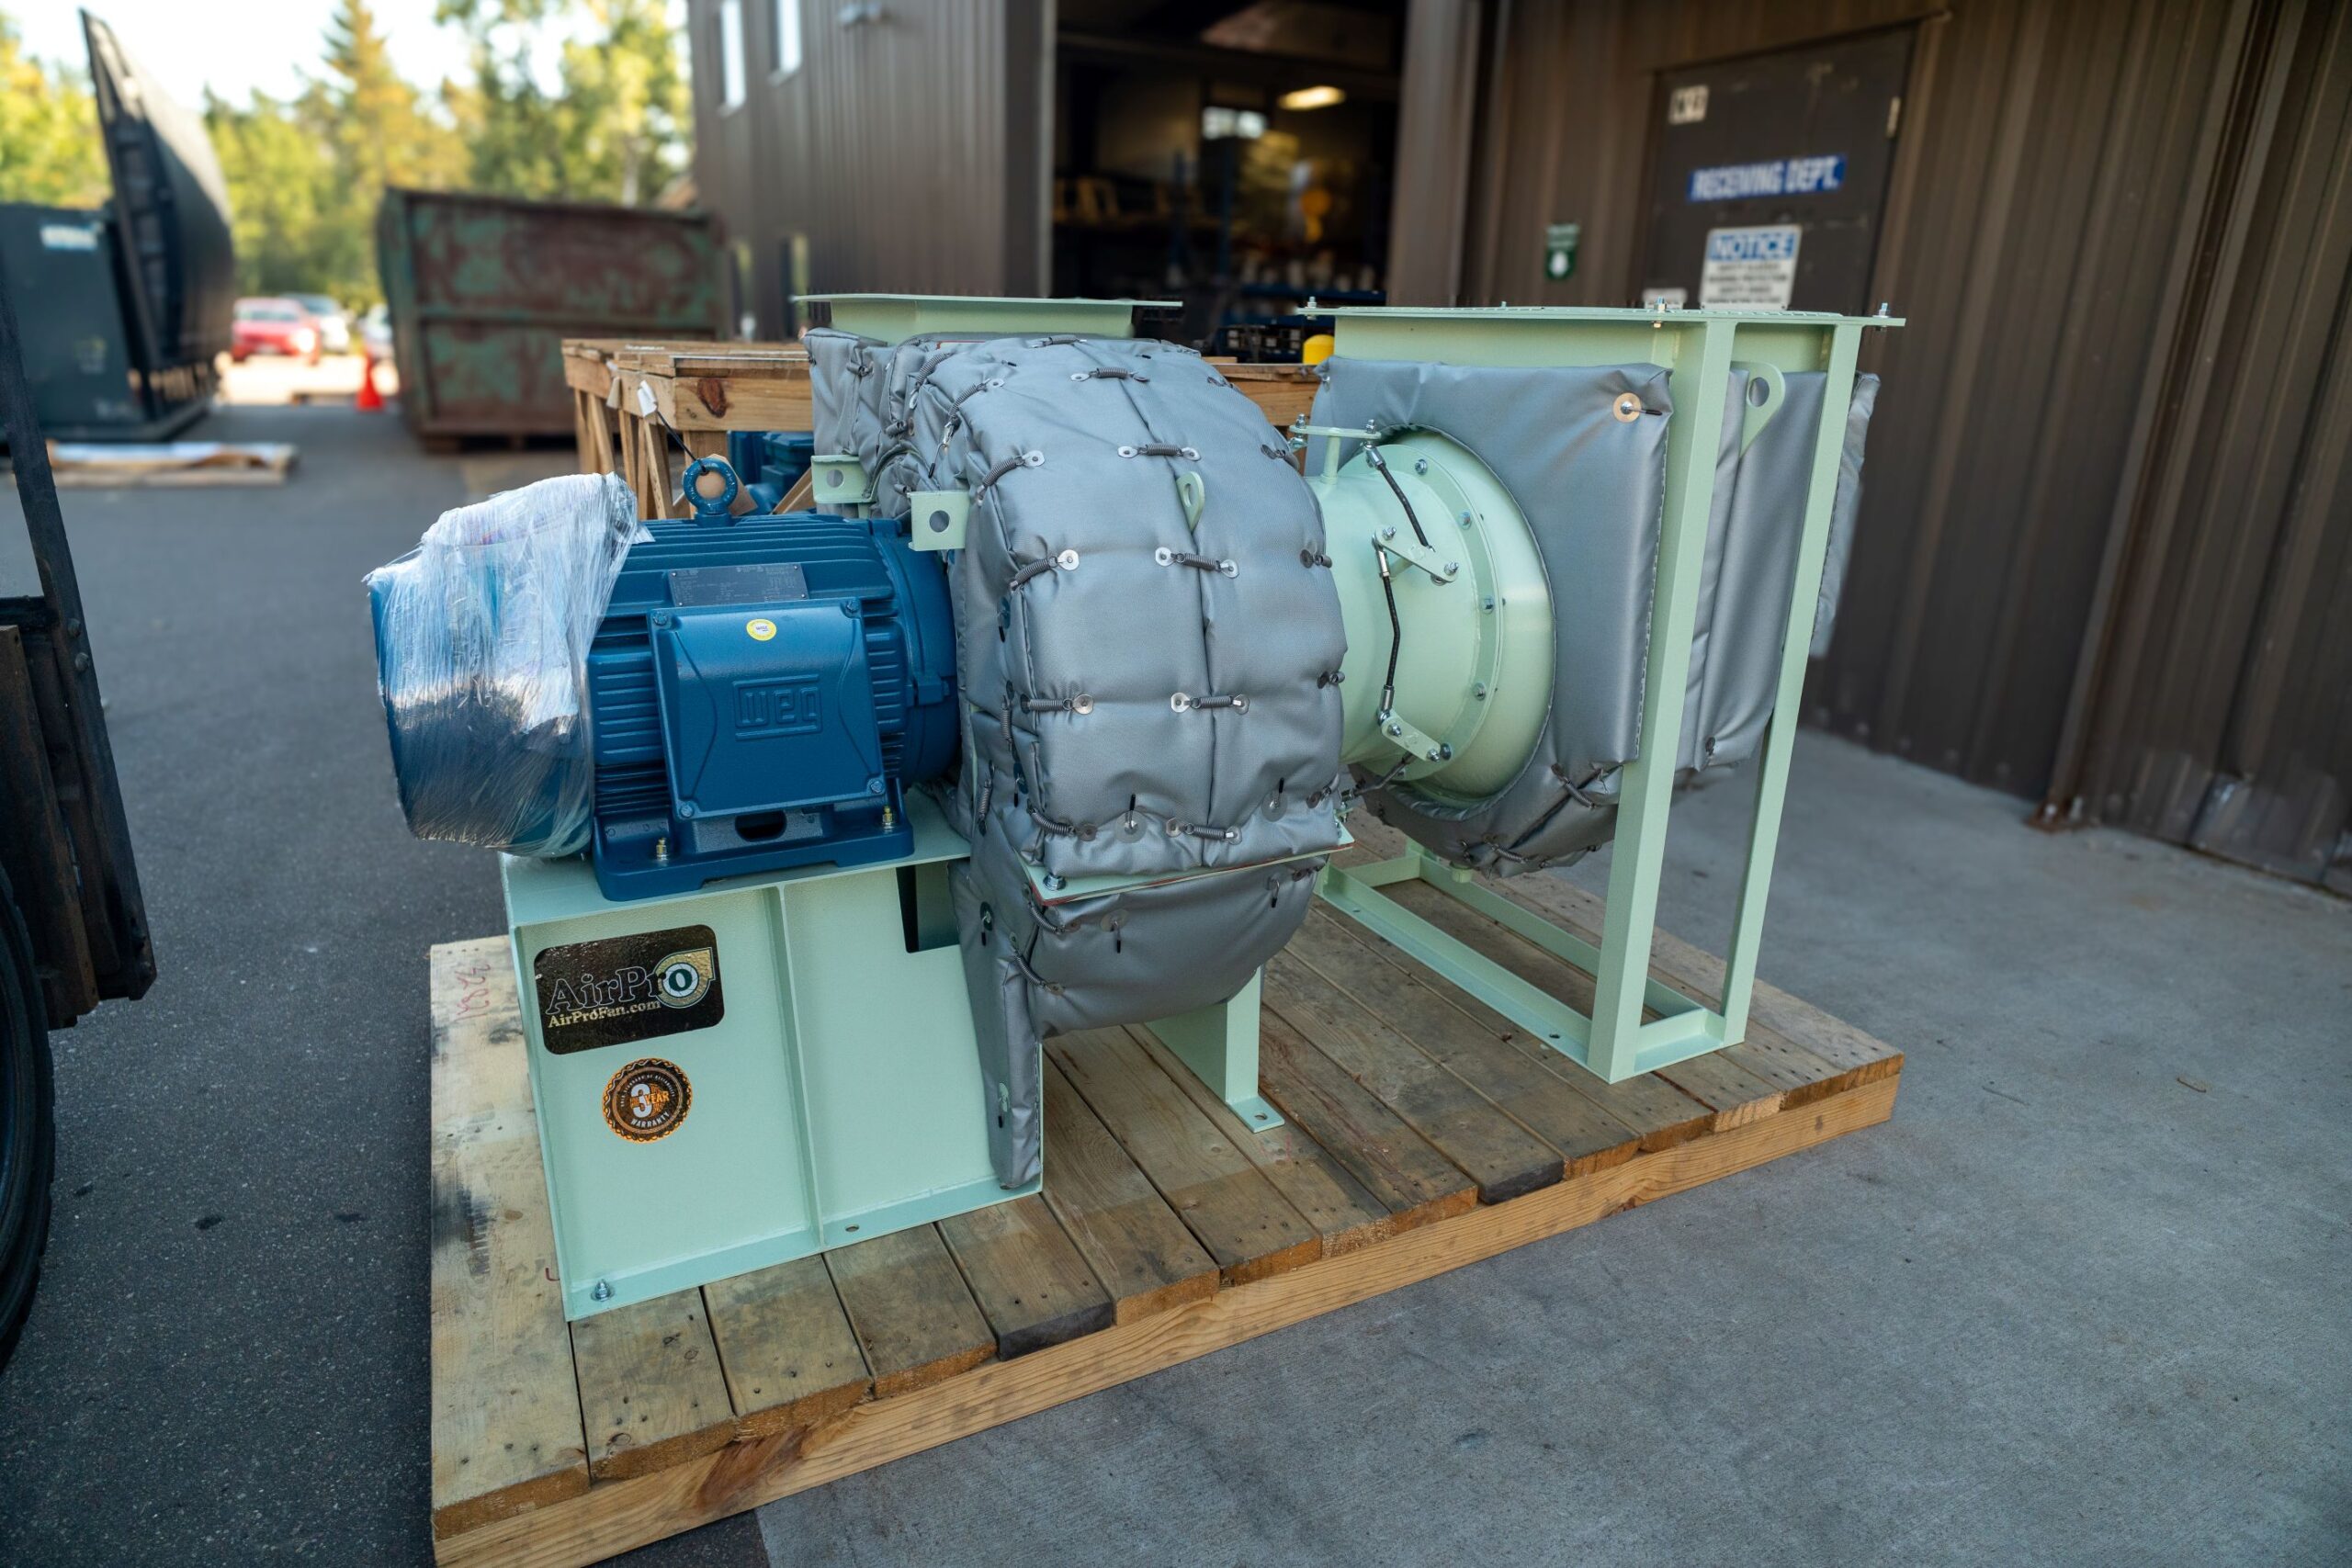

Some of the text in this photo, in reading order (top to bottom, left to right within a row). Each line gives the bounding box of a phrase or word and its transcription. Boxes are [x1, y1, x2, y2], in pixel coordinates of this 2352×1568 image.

[1690, 154, 1840, 201] RECEIVING DEPT.
[1710, 232, 1794, 260] NOTICE
[546, 965, 693, 1014] AirPro
[548, 999, 662, 1029] AirProFan.com
[630, 1083, 653, 1119] 3
[645, 1090, 670, 1106] YEAR
[631, 1111, 670, 1128] WARRANTY
